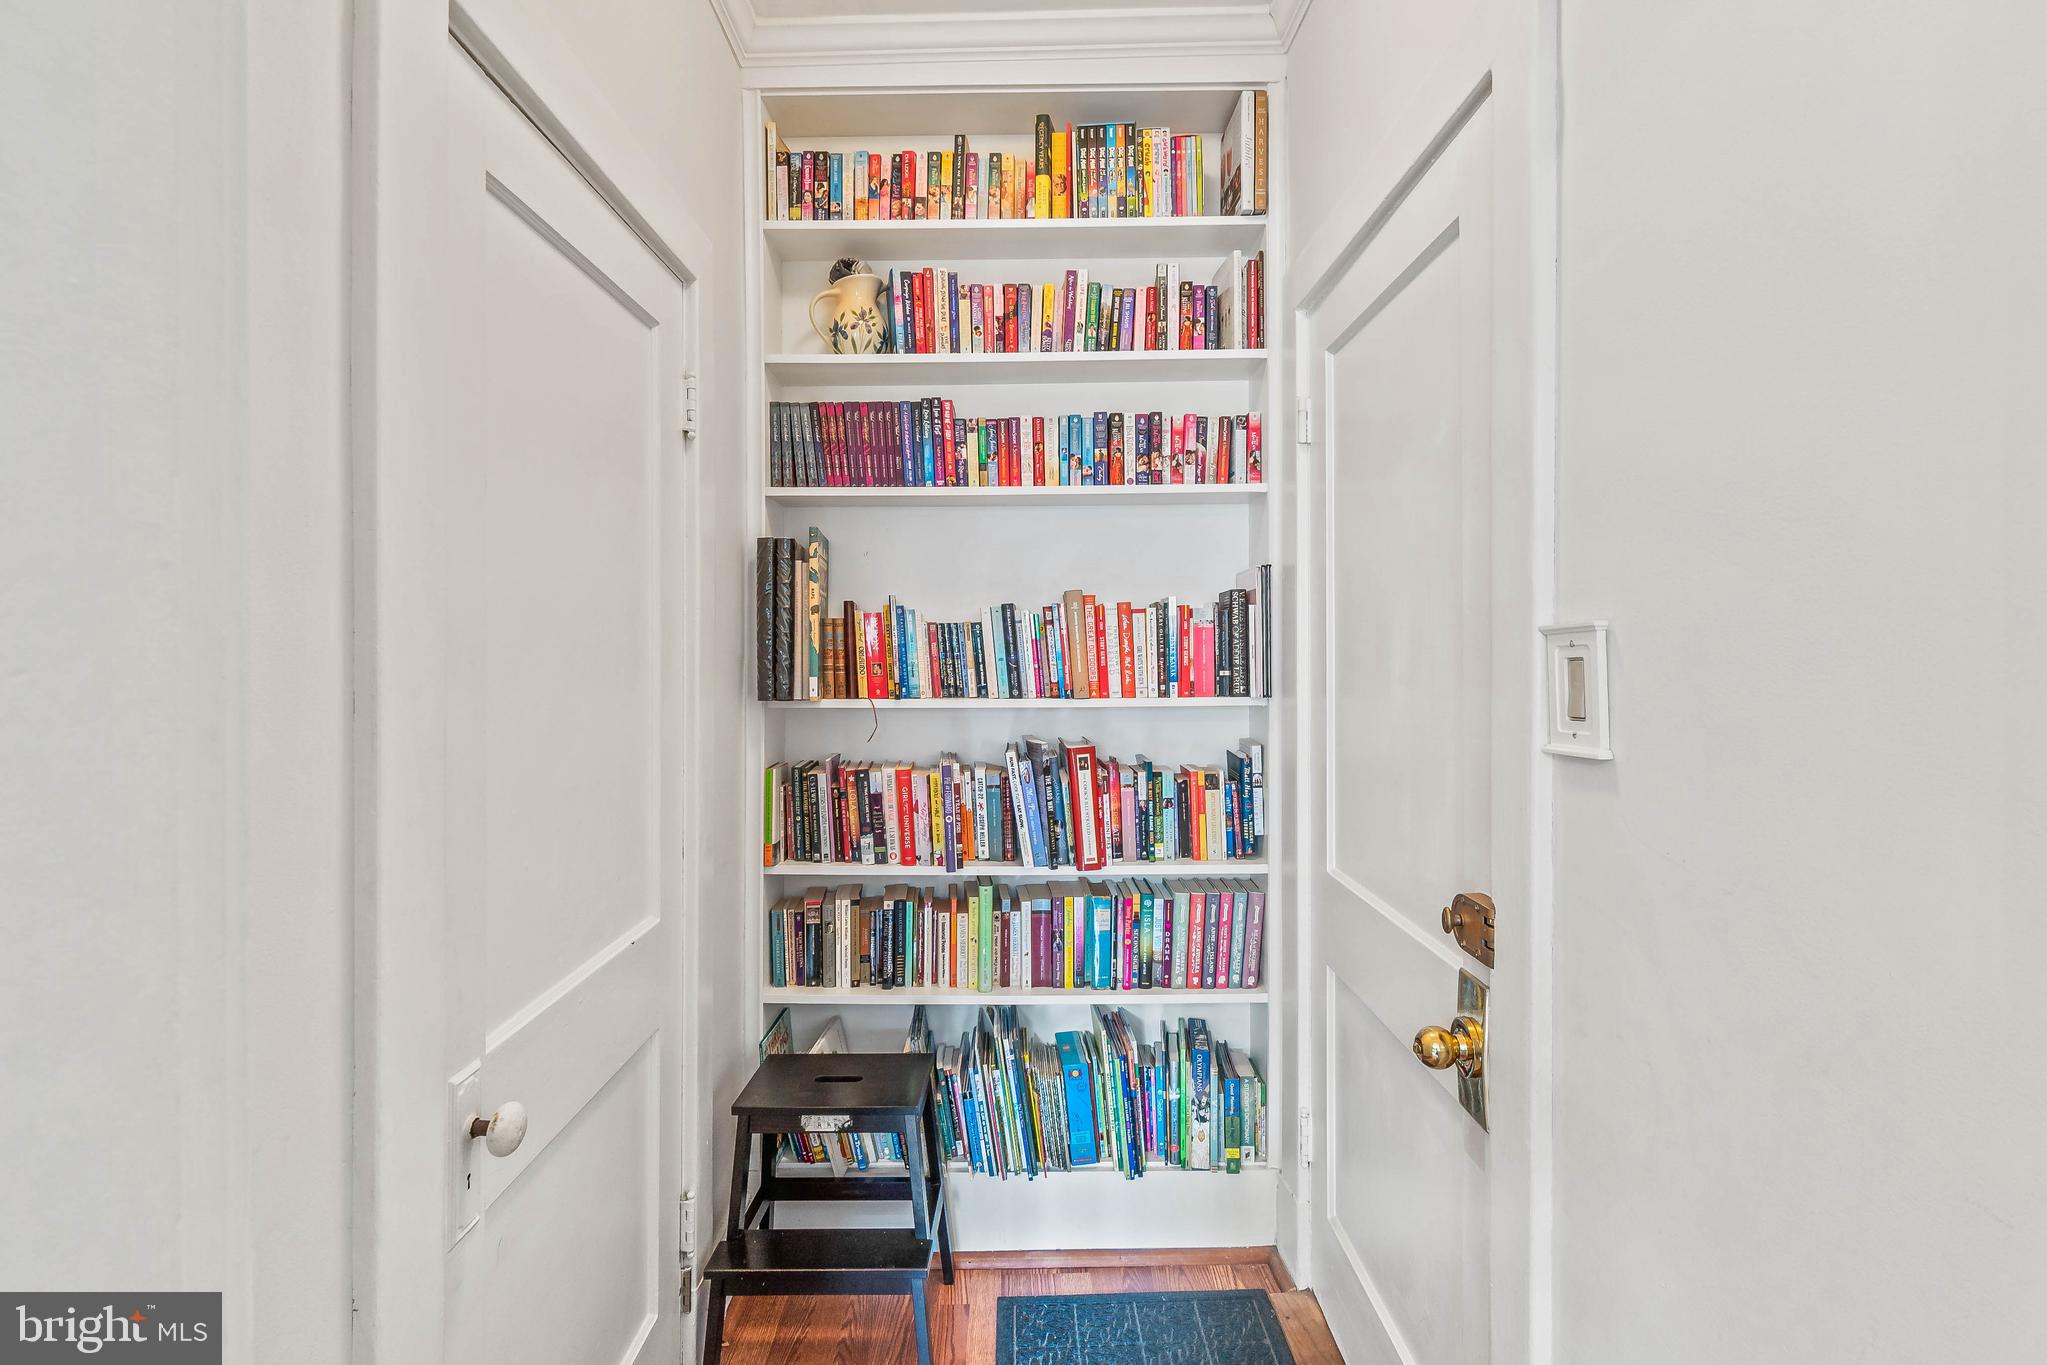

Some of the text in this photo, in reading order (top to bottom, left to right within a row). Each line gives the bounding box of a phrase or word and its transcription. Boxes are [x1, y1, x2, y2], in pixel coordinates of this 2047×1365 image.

[1244, 135, 1253, 169] Jubilee
[903, 280, 911, 300] Campaign
[1089, 644, 1097, 679] OUTDOORS
[902, 787, 910, 802] GIRL
